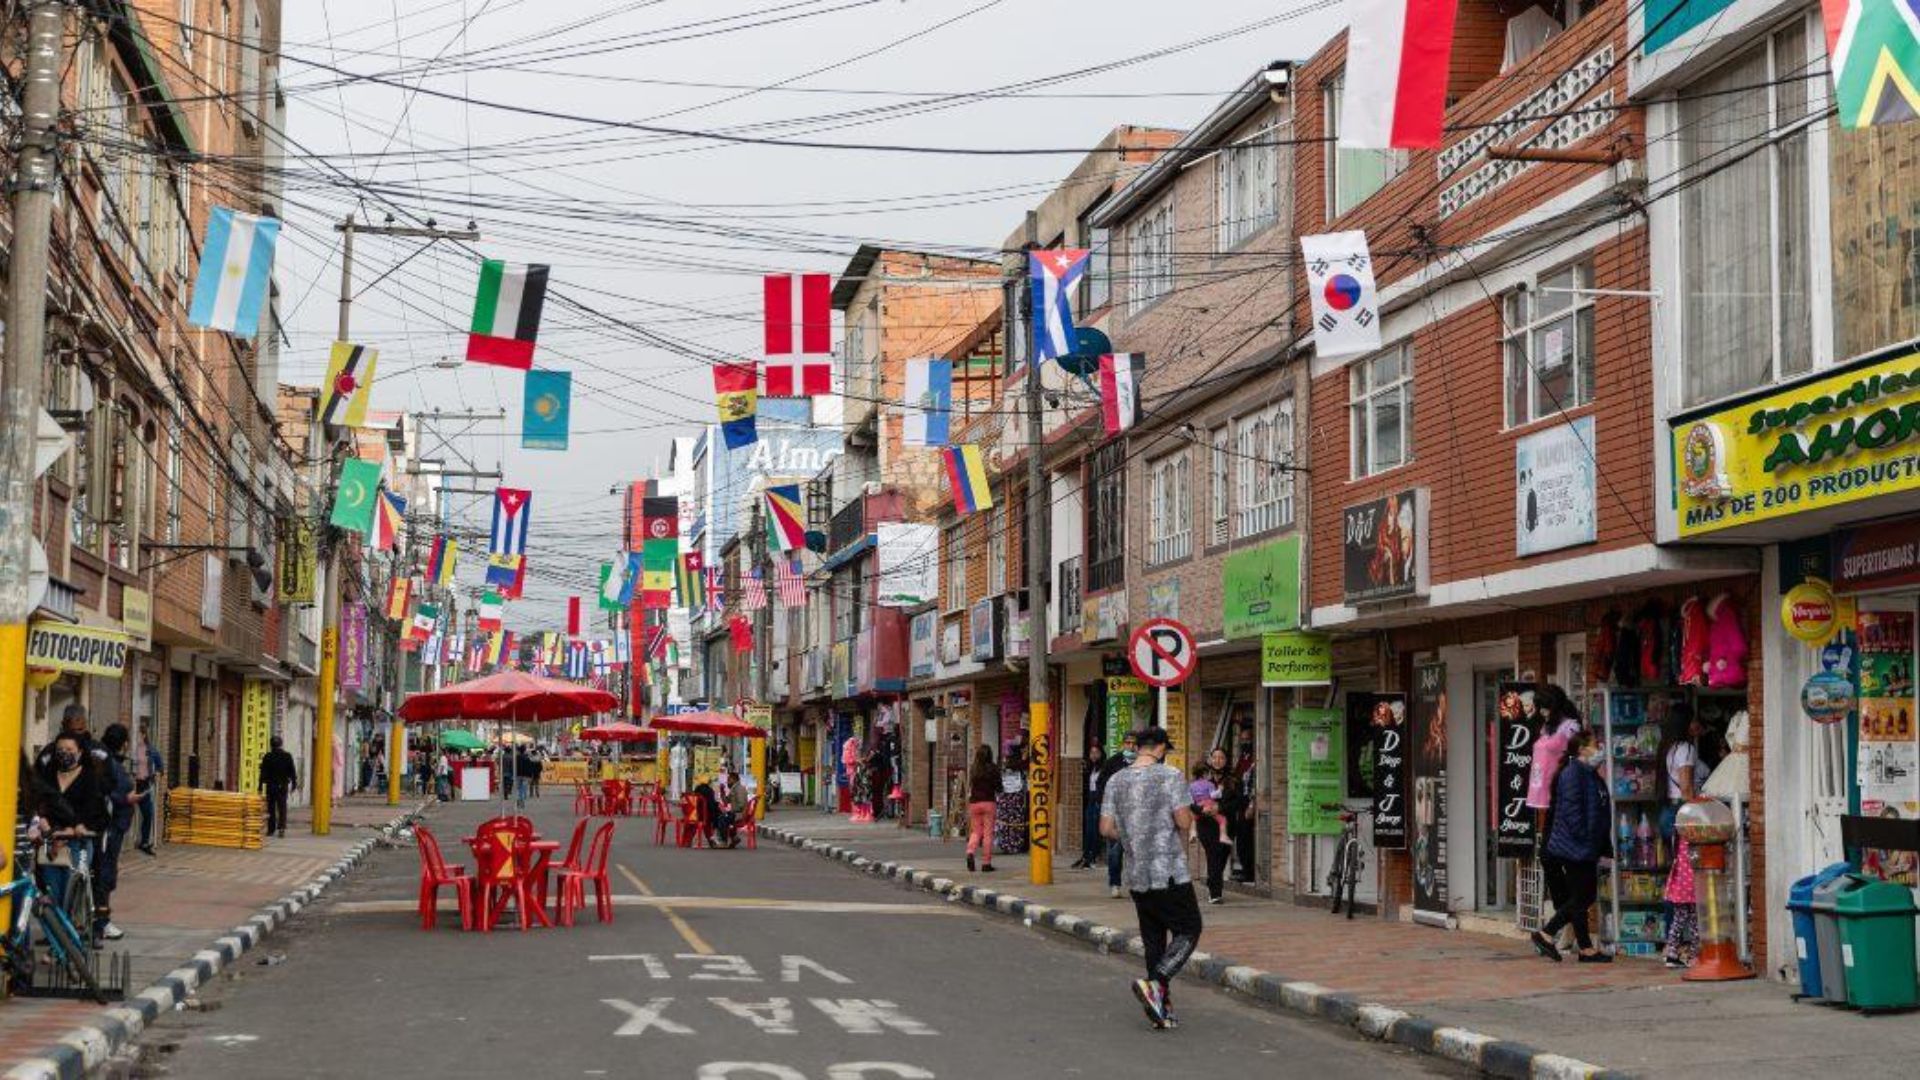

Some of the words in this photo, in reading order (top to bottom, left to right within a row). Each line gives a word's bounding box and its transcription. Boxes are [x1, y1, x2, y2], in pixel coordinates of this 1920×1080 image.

[1686, 502, 1724, 526] MAS
[1731, 495, 1755, 515] DE
[1763, 484, 1801, 508] 200
[1808, 455, 1920, 498] PRODUCT
[1842, 543, 1915, 579] SUPERTIENDAS
[30, 629, 125, 669] FOTOCOPIAS
[1150, 629, 1182, 676] P
[1267, 646, 1304, 658] Taller
[1307, 645, 1322, 657] de
[1267, 661, 1328, 677] Perfumes
[1379, 730, 1400, 751] D
[1507, 724, 1530, 749] D
[1378, 754, 1401, 768] Diego
[1505, 752, 1531, 767] Diego
[1379, 794, 1399, 811] J
[1505, 798, 1527, 817] J
[600, 997, 941, 1036] MAX
